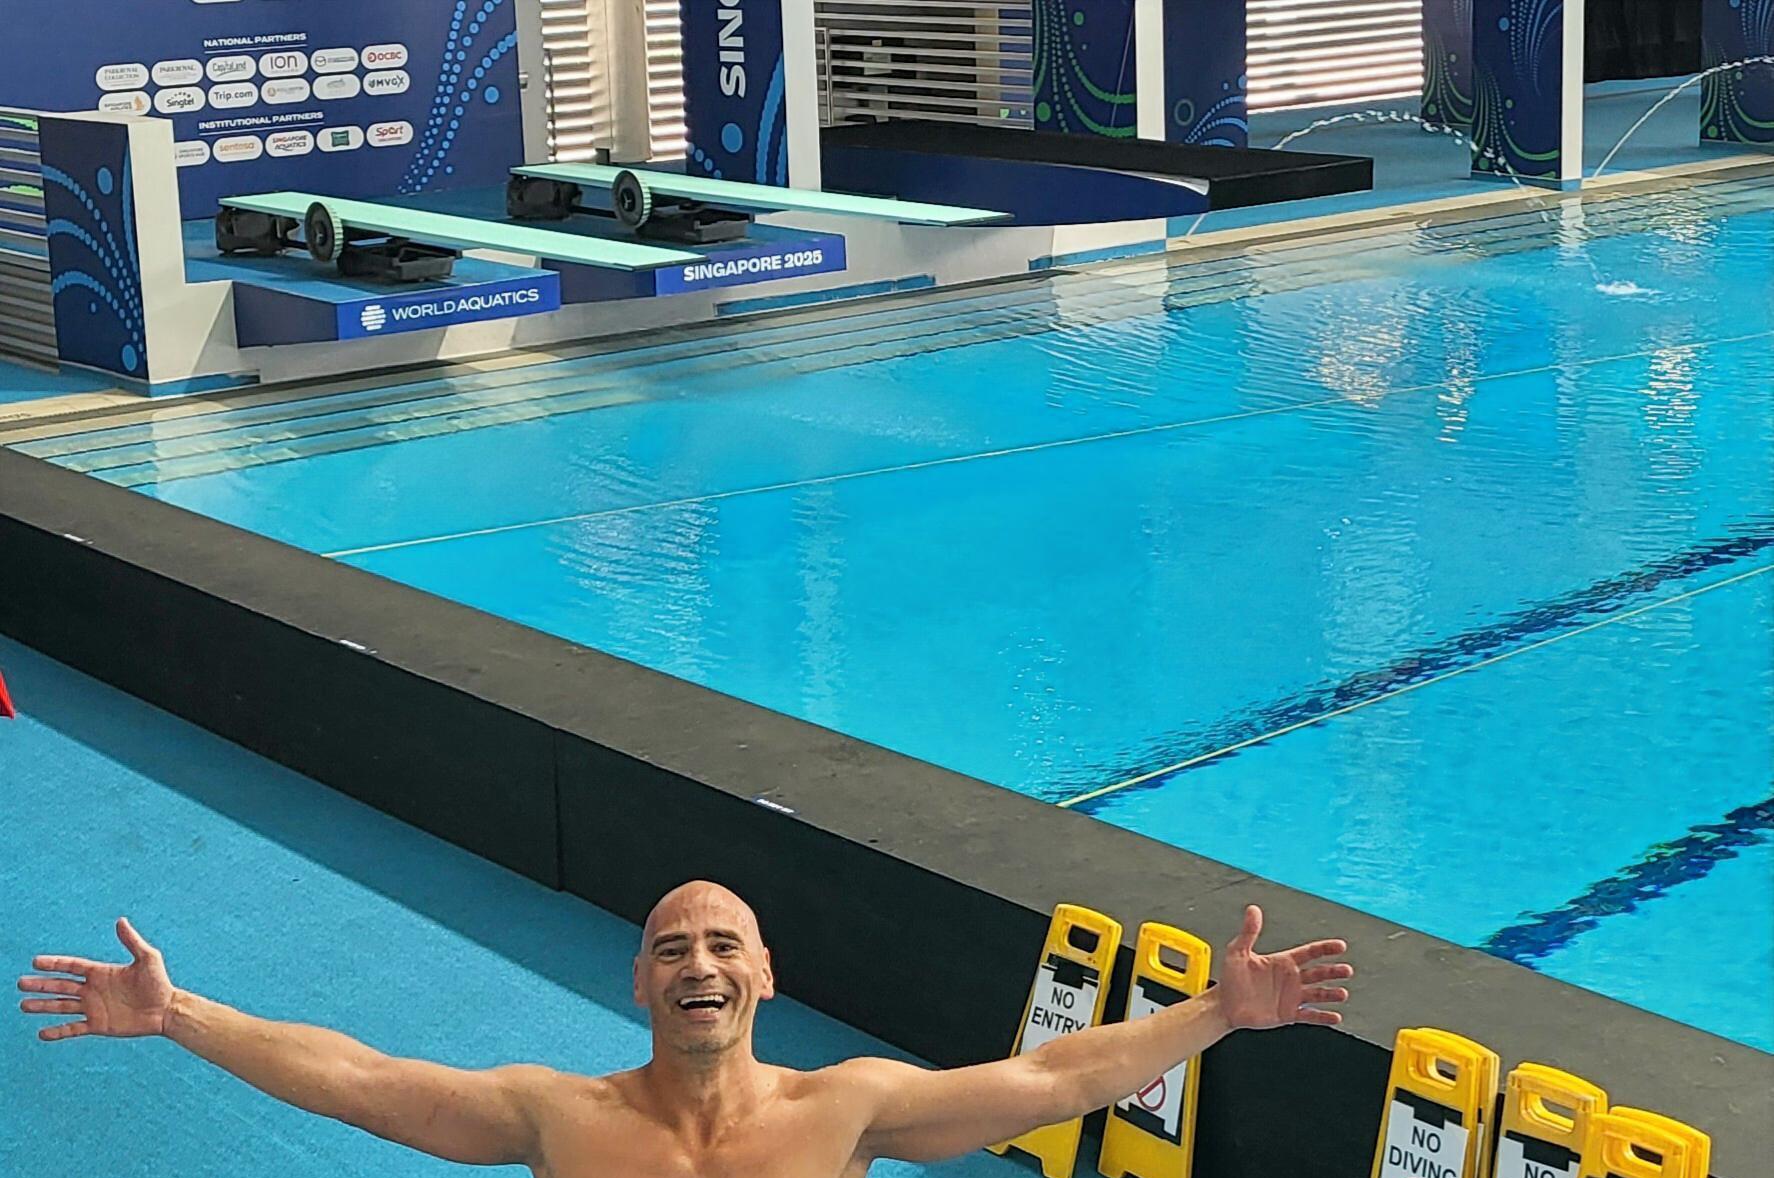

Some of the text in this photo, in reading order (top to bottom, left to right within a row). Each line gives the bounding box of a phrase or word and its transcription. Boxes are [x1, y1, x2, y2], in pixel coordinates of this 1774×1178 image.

[204, 32, 307, 48] NATIONAL PARTNERS
[717, 0, 746, 98] SIN
[377, 51, 402, 61] OCBC
[166, 98, 195, 108] Singtel
[213, 90, 253, 101] Trip.com
[198, 111, 324, 130] INSTITUTIONAL PARTNERS
[683, 249, 823, 282] SINGAPORE 2025
[391, 288, 540, 321] WORLD AQUATICS
[1050, 986, 1075, 1009] NO
[1031, 1006, 1086, 1034] ENTRY
[1411, 1125, 1441, 1153] NO
